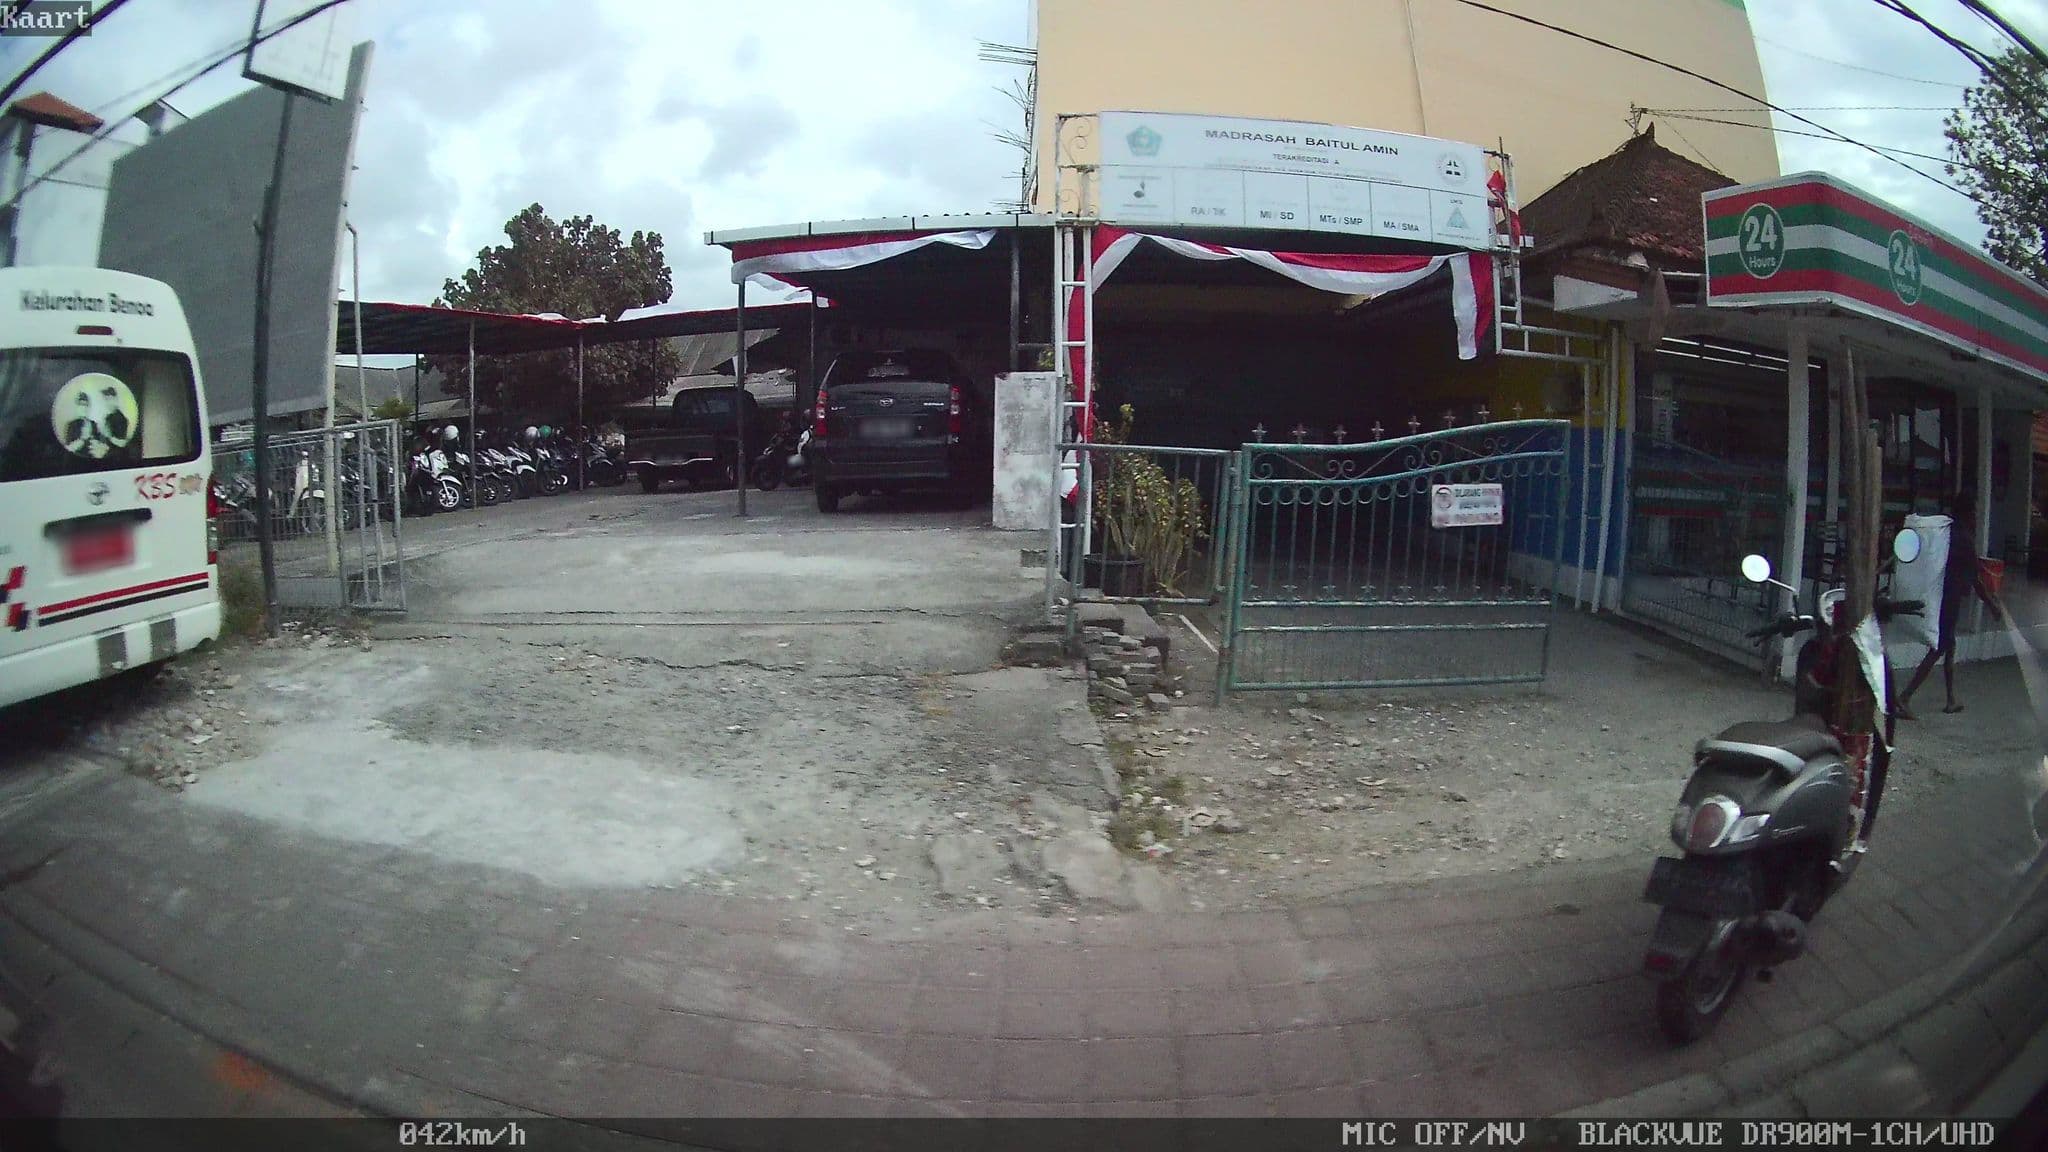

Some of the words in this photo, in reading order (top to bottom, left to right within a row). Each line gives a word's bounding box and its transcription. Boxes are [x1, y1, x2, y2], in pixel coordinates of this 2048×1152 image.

[1205, 129, 1296, 145] MADRASAH
[1305, 137, 1359, 151] BAITUL
[1362, 143, 1399, 156] AMIN
[1280, 211, 1294, 221] SD
[1320, 214, 1336, 224] MTs
[1344, 217, 1362, 226] SMP
[1384, 221, 1396, 230] MA
[1402, 223, 1419, 232] SMA
[1745, 214, 1777, 251] 24
[1749, 256, 1776, 268] Hours
[1892, 239, 1915, 280] 24
[20, 291, 104, 312] Kelurahan
[109, 292, 154, 316] Benoa
